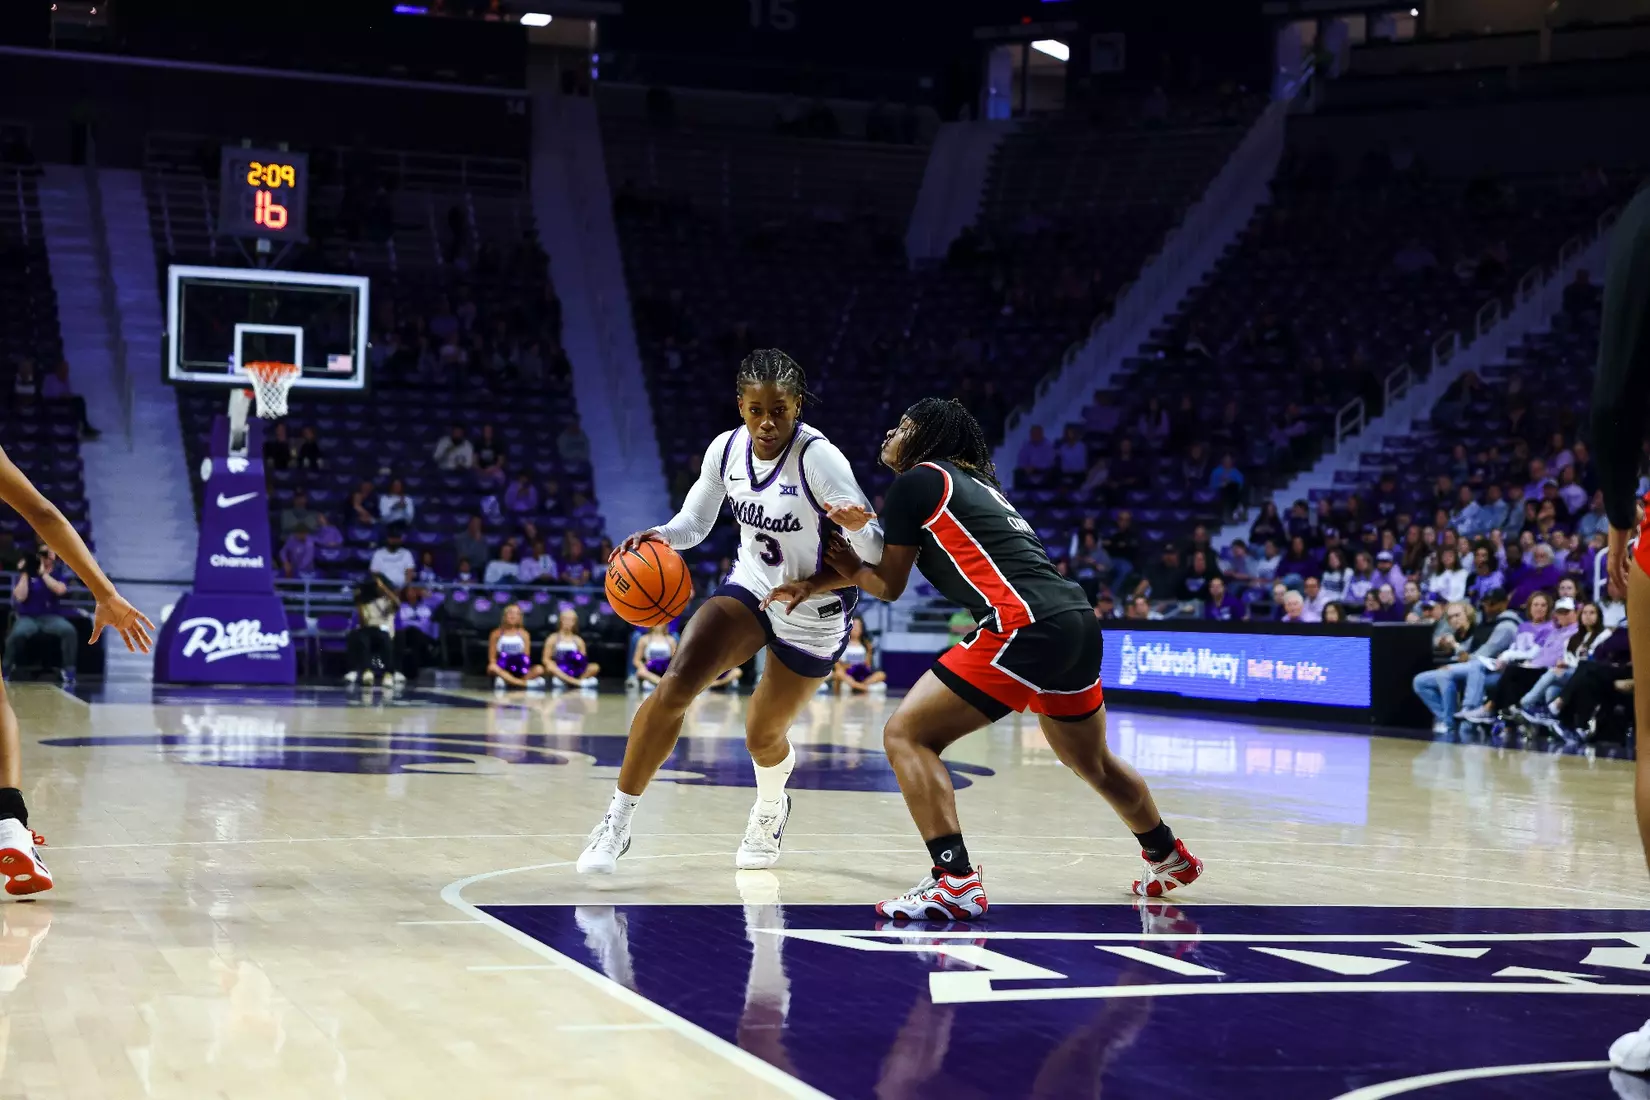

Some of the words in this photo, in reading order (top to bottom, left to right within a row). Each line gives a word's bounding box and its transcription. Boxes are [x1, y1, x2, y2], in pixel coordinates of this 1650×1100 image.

[748, 0, 797, 31] 15
[247, 161, 295, 188] 2:09
[254, 189, 288, 230] 16
[728, 495, 803, 532] Wildcats
[210, 554, 264, 568] Channel
[754, 532, 784, 567] 3
[178, 616, 289, 658] Dillons
[1197, 648, 1239, 684] Mercy
